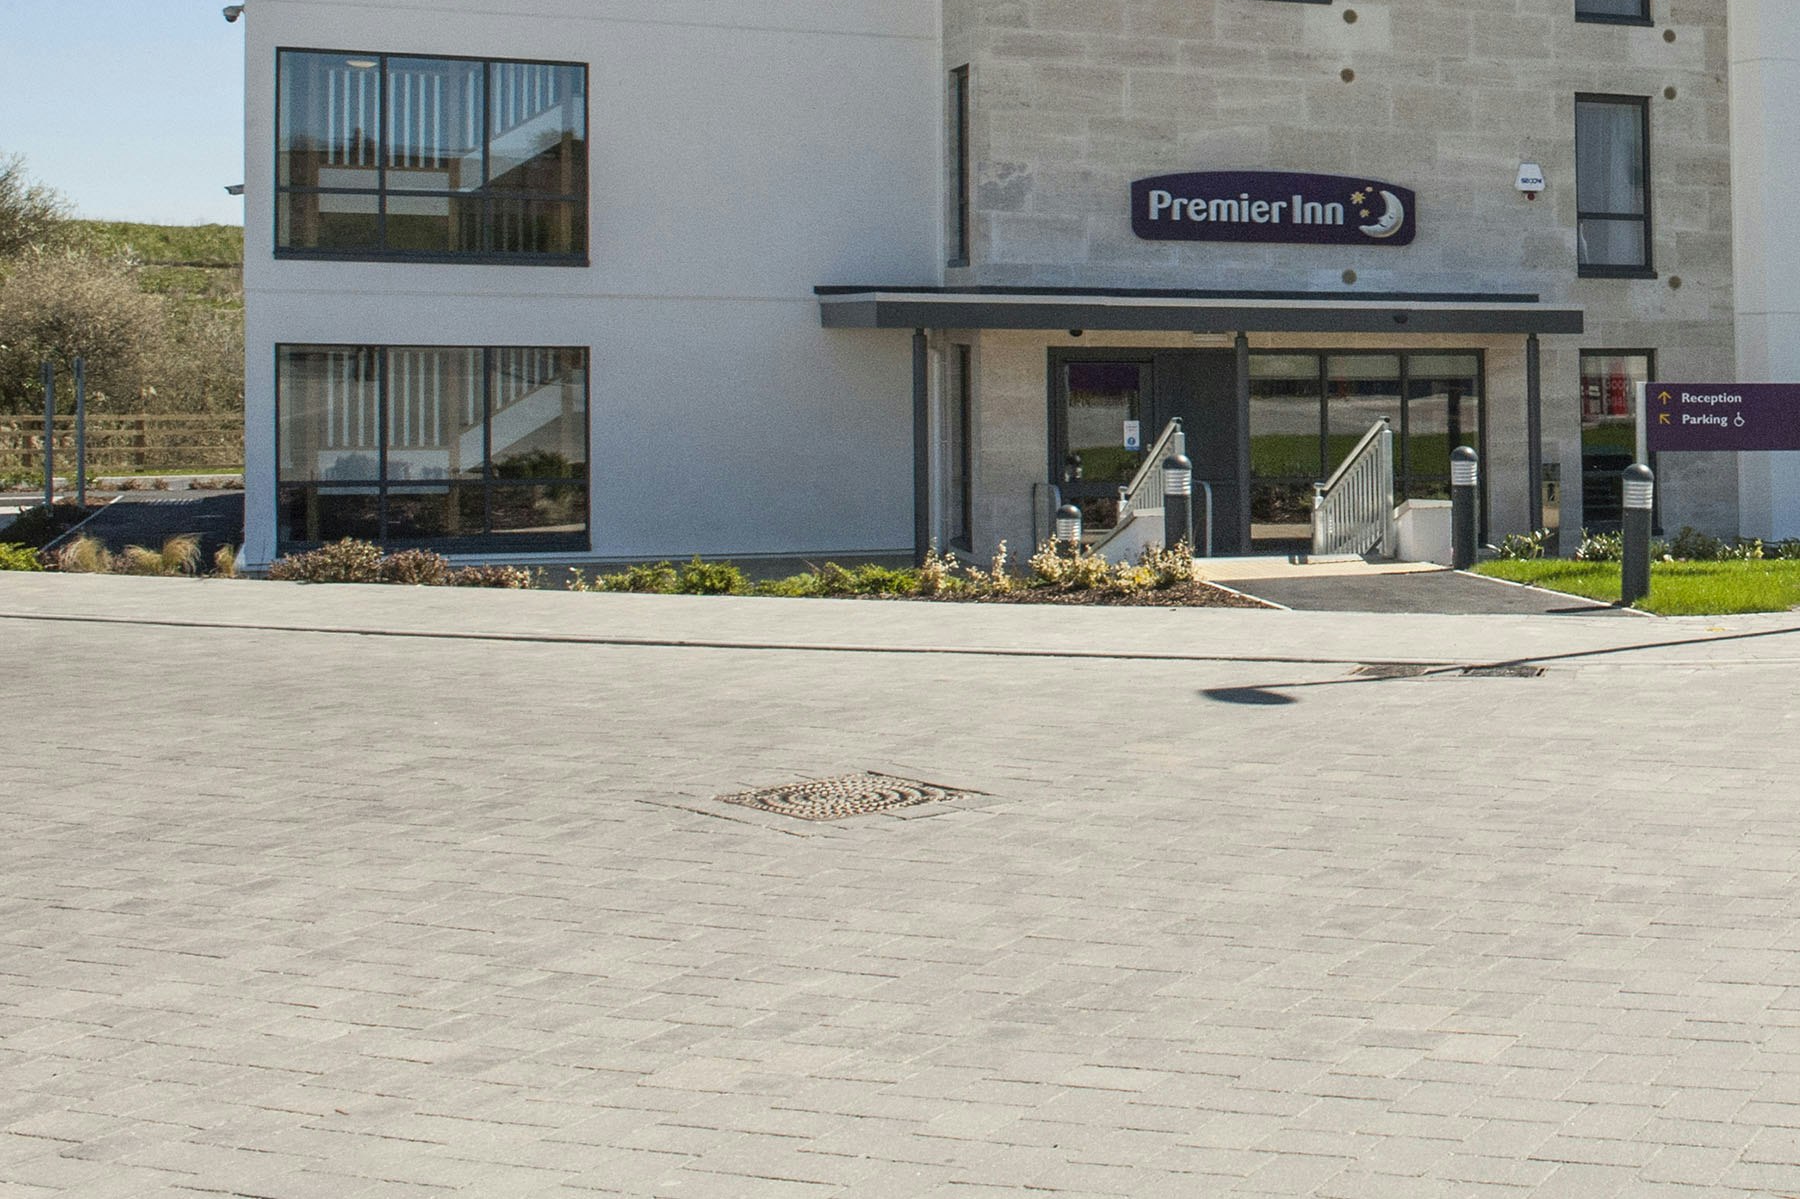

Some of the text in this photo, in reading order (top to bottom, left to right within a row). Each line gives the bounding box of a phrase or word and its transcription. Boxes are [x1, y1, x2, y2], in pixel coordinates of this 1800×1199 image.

[1149, 189, 1344, 225] Premier Inn
[1682, 392, 1742, 406] Reception
[1682, 414, 1728, 427] Parking
